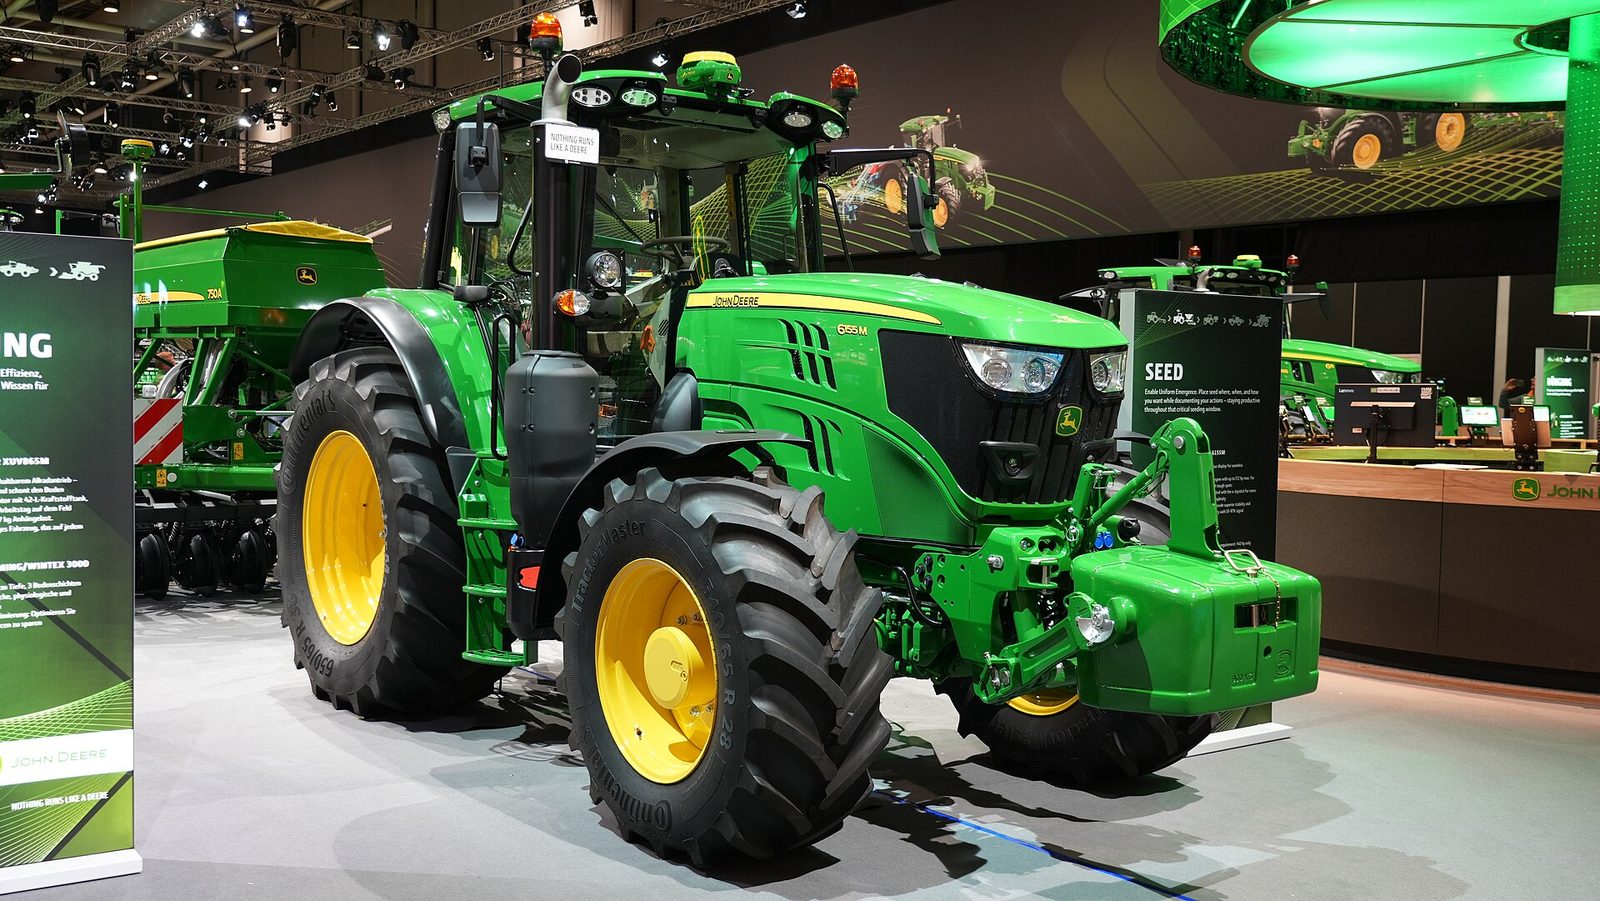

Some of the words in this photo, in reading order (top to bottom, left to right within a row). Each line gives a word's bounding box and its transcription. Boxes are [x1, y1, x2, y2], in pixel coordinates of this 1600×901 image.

[551, 133, 577, 144] NOTHING
[579, 136, 594, 146] RUNS
[550, 142, 563, 151] LIKE
[570, 145, 587, 154] DEERE
[207, 288, 222, 300] 750A
[712, 296, 732, 307] JOHN
[732, 294, 759, 306] DEERE
[0, 332, 52, 358] NG
[0, 368, 42, 379] Effizienz,
[1145, 362, 1184, 381] SEED
[1, 380, 33, 390] Wissen
[34, 380, 48, 390] für
[1176, 388, 1198, 396] Emergence.
[3, 457, 50, 466] XUV865M
[1547, 484, 1594, 498] JOHN
[3, 516, 12, 524] kg
[9, 525, 39, 533] Fahrzeug,
[66, 560, 90, 568] 3000
[723, 688, 736, 705] R
[718, 716, 734, 750] 28
[11, 756, 52, 768] JOHN
[58, 749, 107, 763] DEERE
[11, 800, 44, 811] NOTHING
[45, 796, 64, 806] RUNS
[65, 794, 81, 804] LIKE
[81, 794, 86, 802] A
[87, 791, 108, 801] DEERE
